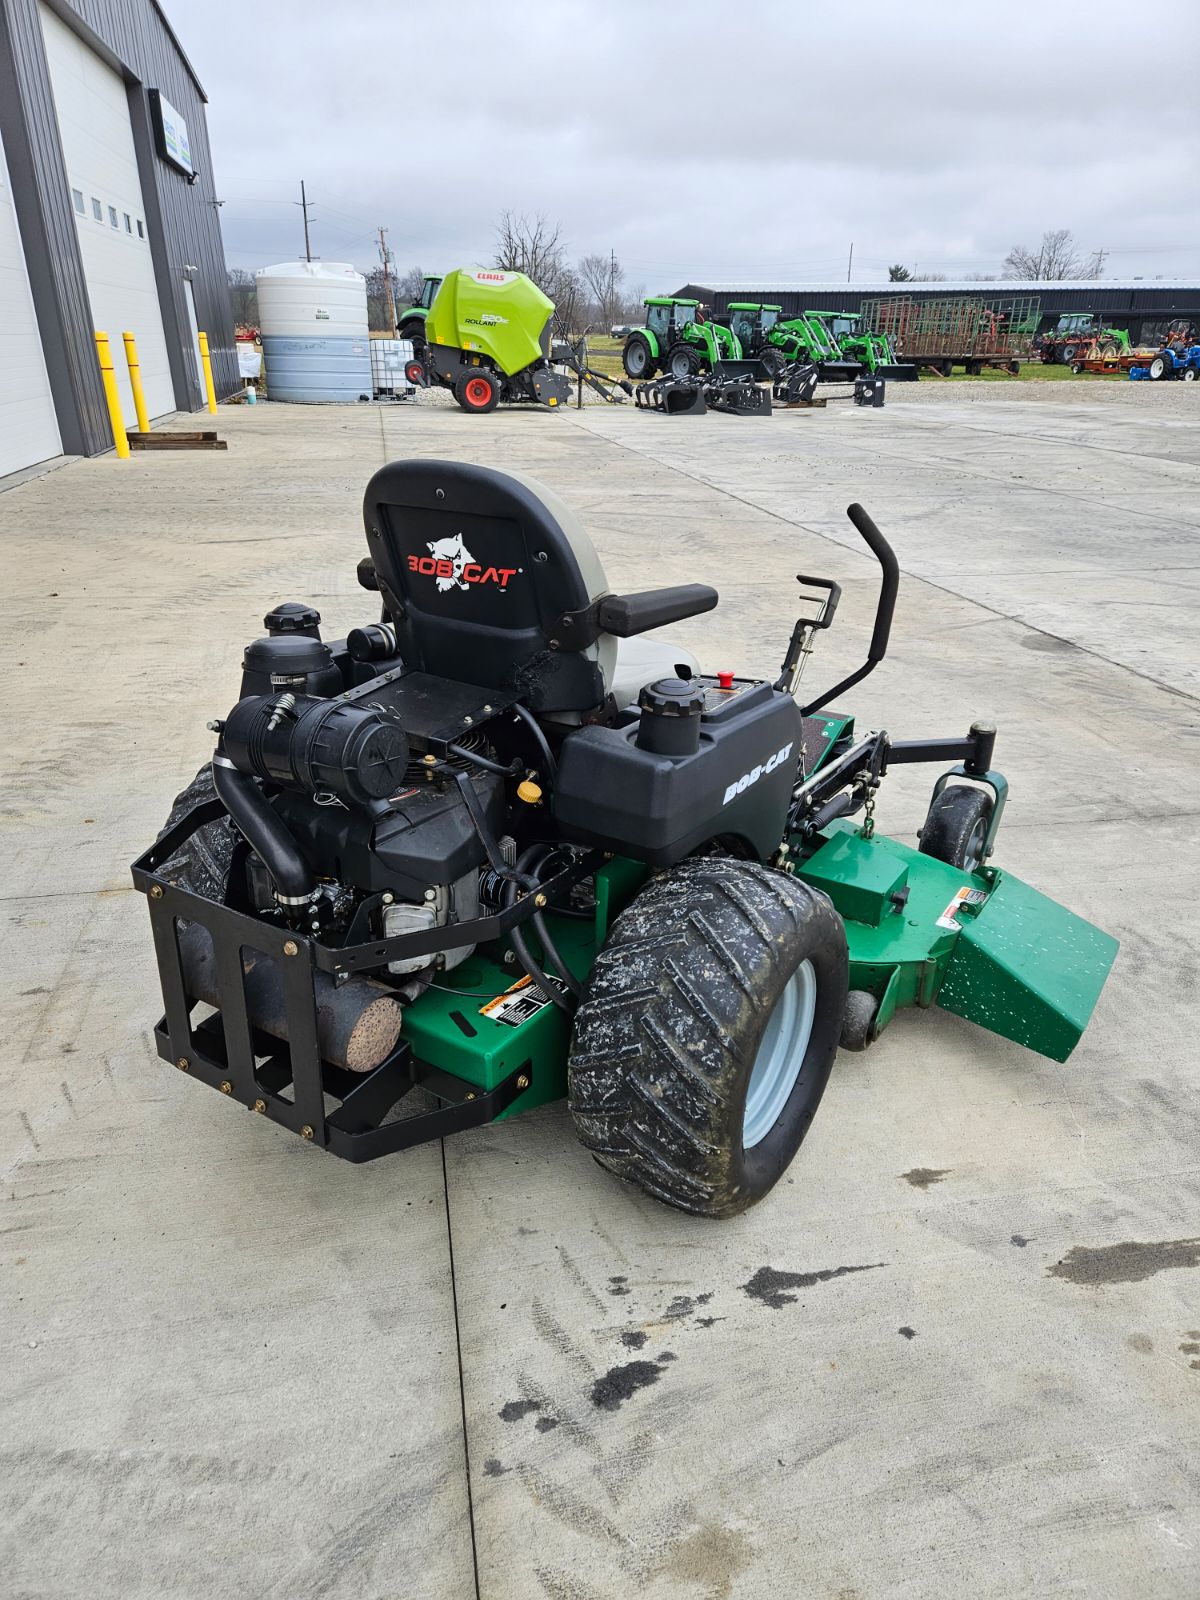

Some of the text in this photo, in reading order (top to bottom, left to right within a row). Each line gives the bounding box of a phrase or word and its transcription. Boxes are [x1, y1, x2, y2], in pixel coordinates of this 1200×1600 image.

[477, 273, 504, 281] CLAAS
[464, 318, 497, 327] ROLLANT
[464, 565, 517, 586] CAT
[723, 742, 793, 805] BOB-CAT
